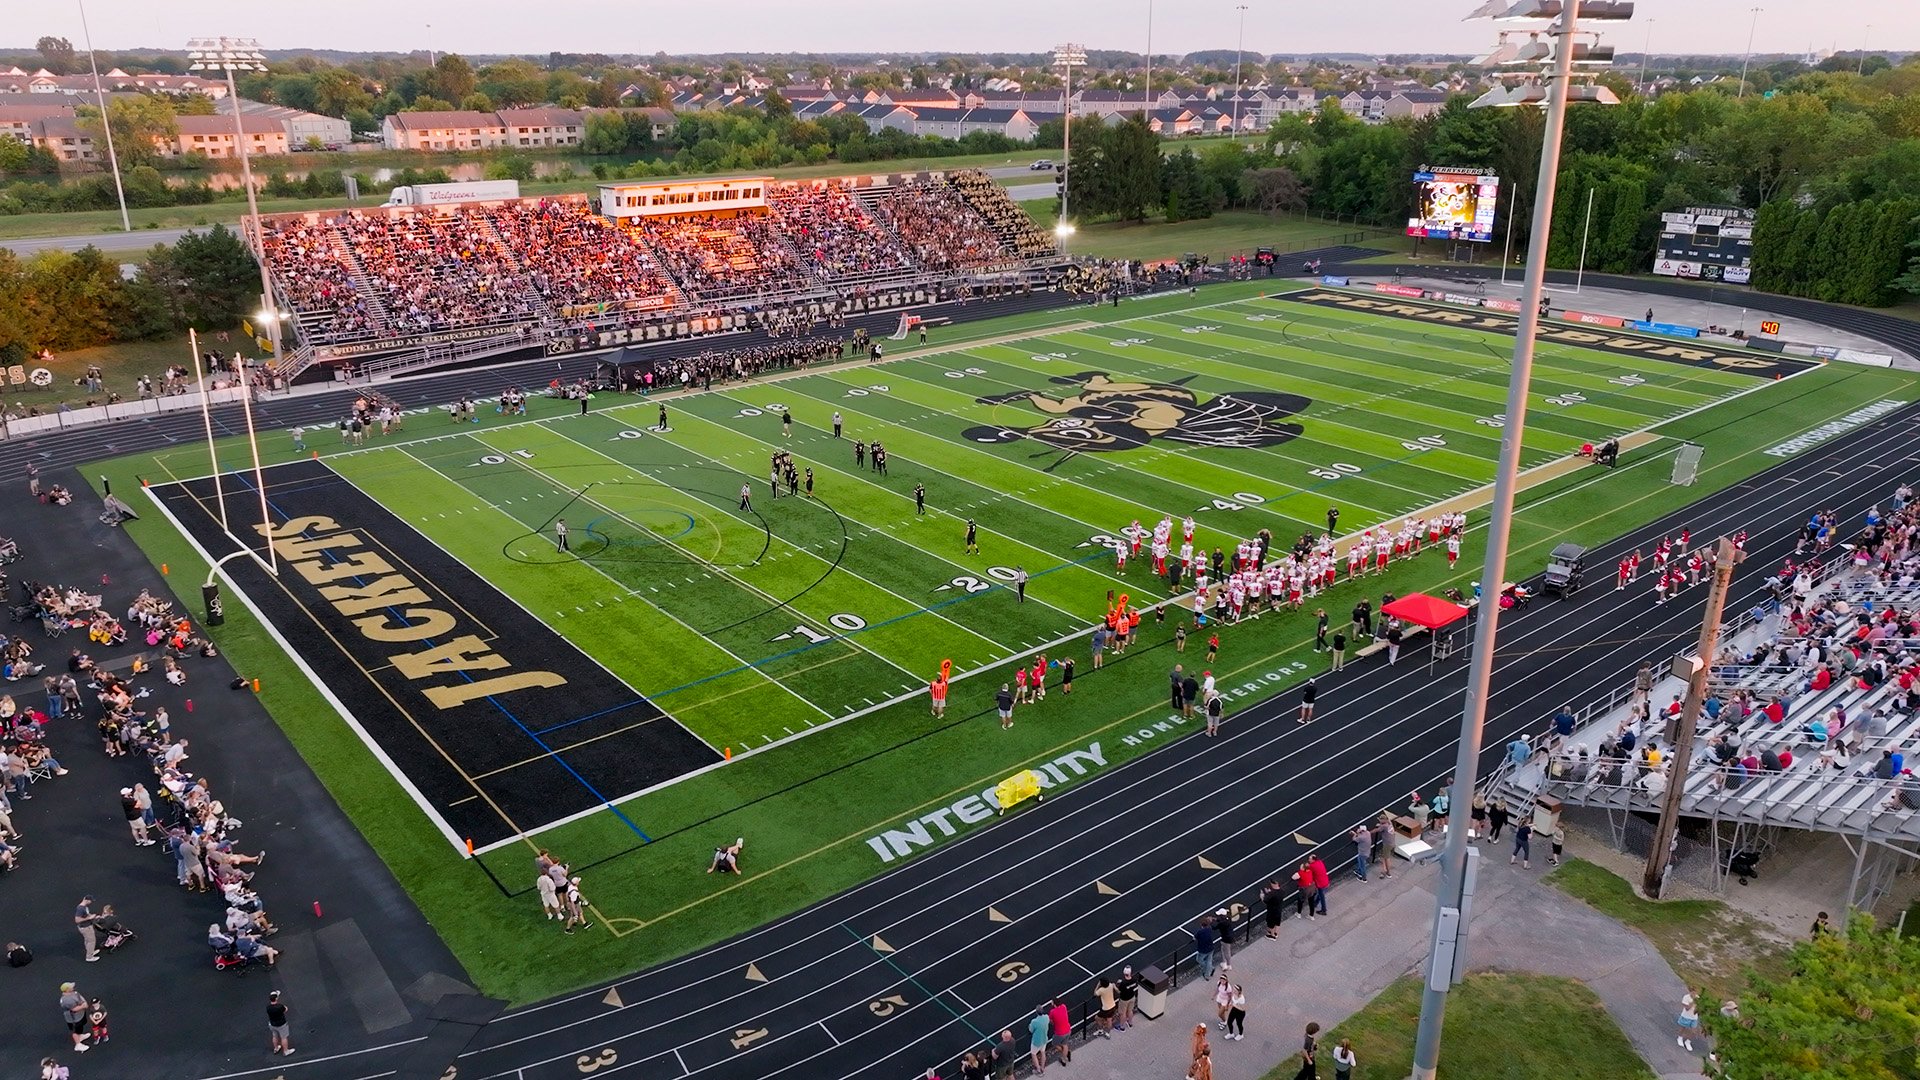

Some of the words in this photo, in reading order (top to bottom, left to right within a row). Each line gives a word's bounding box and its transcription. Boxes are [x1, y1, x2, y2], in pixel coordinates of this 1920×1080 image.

[1430, 166, 1484, 175] PERRYSBURG
[429, 190, 476, 201] Walgreens
[1685, 207, 1739, 218] PERRYSBURG
[635, 298, 664, 308] HEROES
[599, 314, 747, 347] PERRYSBURG
[843, 290, 926, 314] JACKETS
[1580, 315, 1603, 325] BGSU
[1762, 321, 1778, 335] 40
[332, 343, 373, 357] WIDDEL
[375, 339, 404, 351] FIELD
[406, 337, 419, 348] AT
[420, 328, 482, 347] STEINECKER
[1400, 436, 1447, 453] 40
[1763, 420, 1856, 458] PERRYSBURG
[1307, 462, 1363, 481] 50
[1211, 490, 1267, 512] 40
[951, 564, 1023, 594] 20
[252, 514, 568, 710] JACKETS
[791, 611, 869, 646] 10
[1122, 714, 1187, 747] HOME
[1194, 661, 1308, 716] ETERIORS
[1111, 928, 1146, 949] 7
[995, 960, 1032, 984] 6
[868, 994, 910, 1018] 5
[730, 1026, 770, 1050] 4
[576, 1047, 619, 1074] 3
